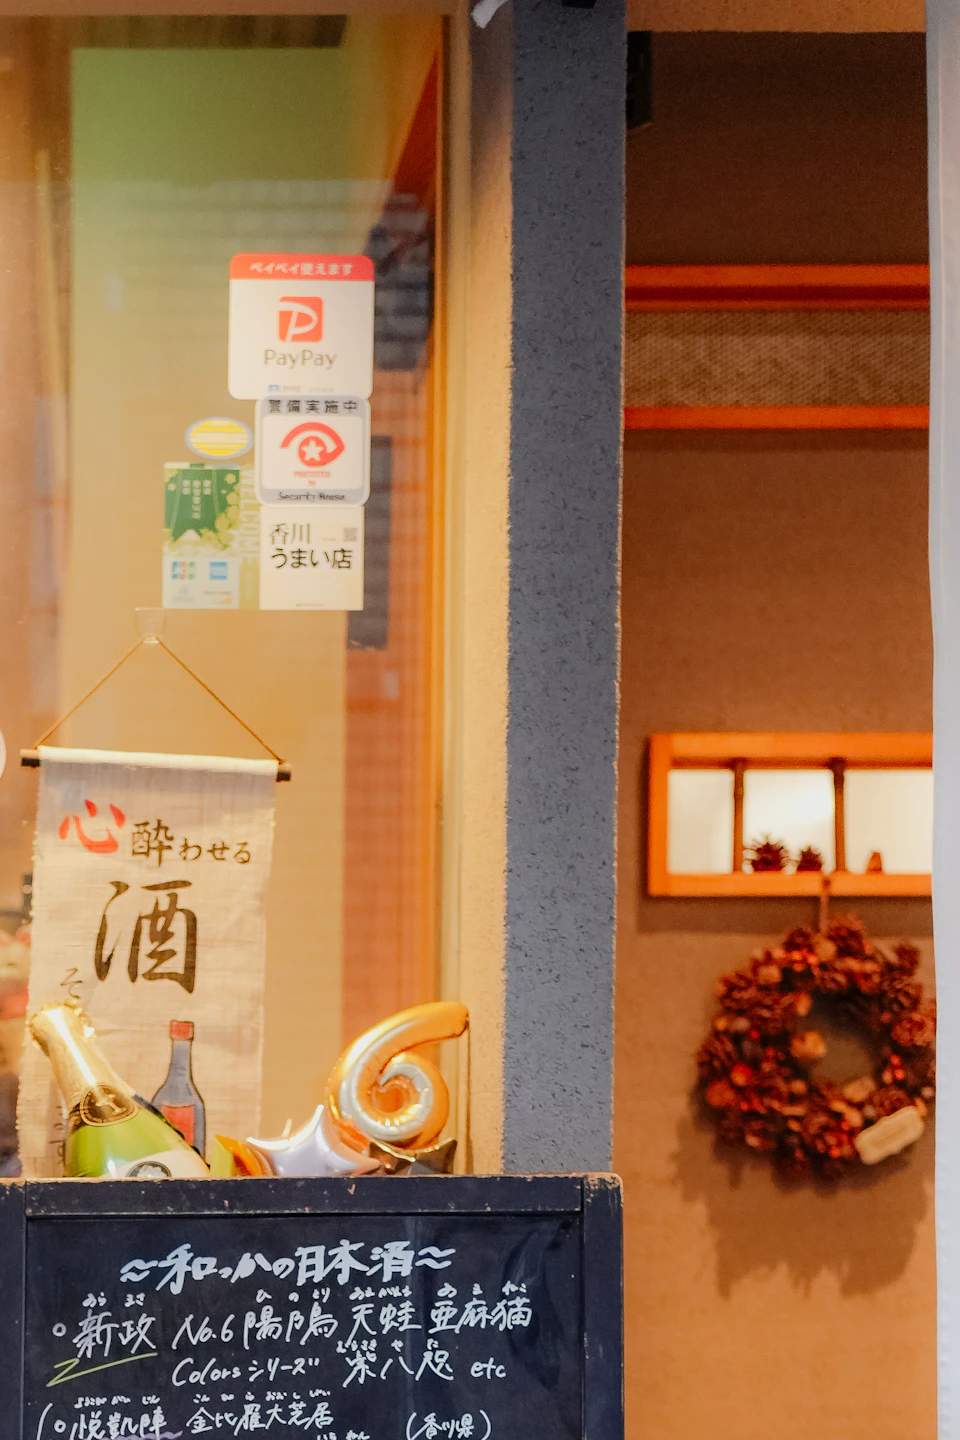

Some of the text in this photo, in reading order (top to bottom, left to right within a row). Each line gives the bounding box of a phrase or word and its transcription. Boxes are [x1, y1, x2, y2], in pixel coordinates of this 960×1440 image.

[249, 262, 353, 276] ペイペイ使えます
[264, 349, 339, 370] PayPay
[268, 399, 358, 414] 警備実施中
[269, 523, 311, 545] 香川
[270, 548, 353, 570] うまい店
[93, 880, 198, 994] 酒
[72, 1309, 157, 1358] 新政
[171, 1313, 236, 1350] No.6
[347, 1300, 422, 1346] 天蛙
[428, 1297, 533, 1333] 亜麻猫
[171, 1357, 241, 1386] Colors
[247, 1357, 320, 1382] シリーズ
[470, 1357, 507, 1380] etc
